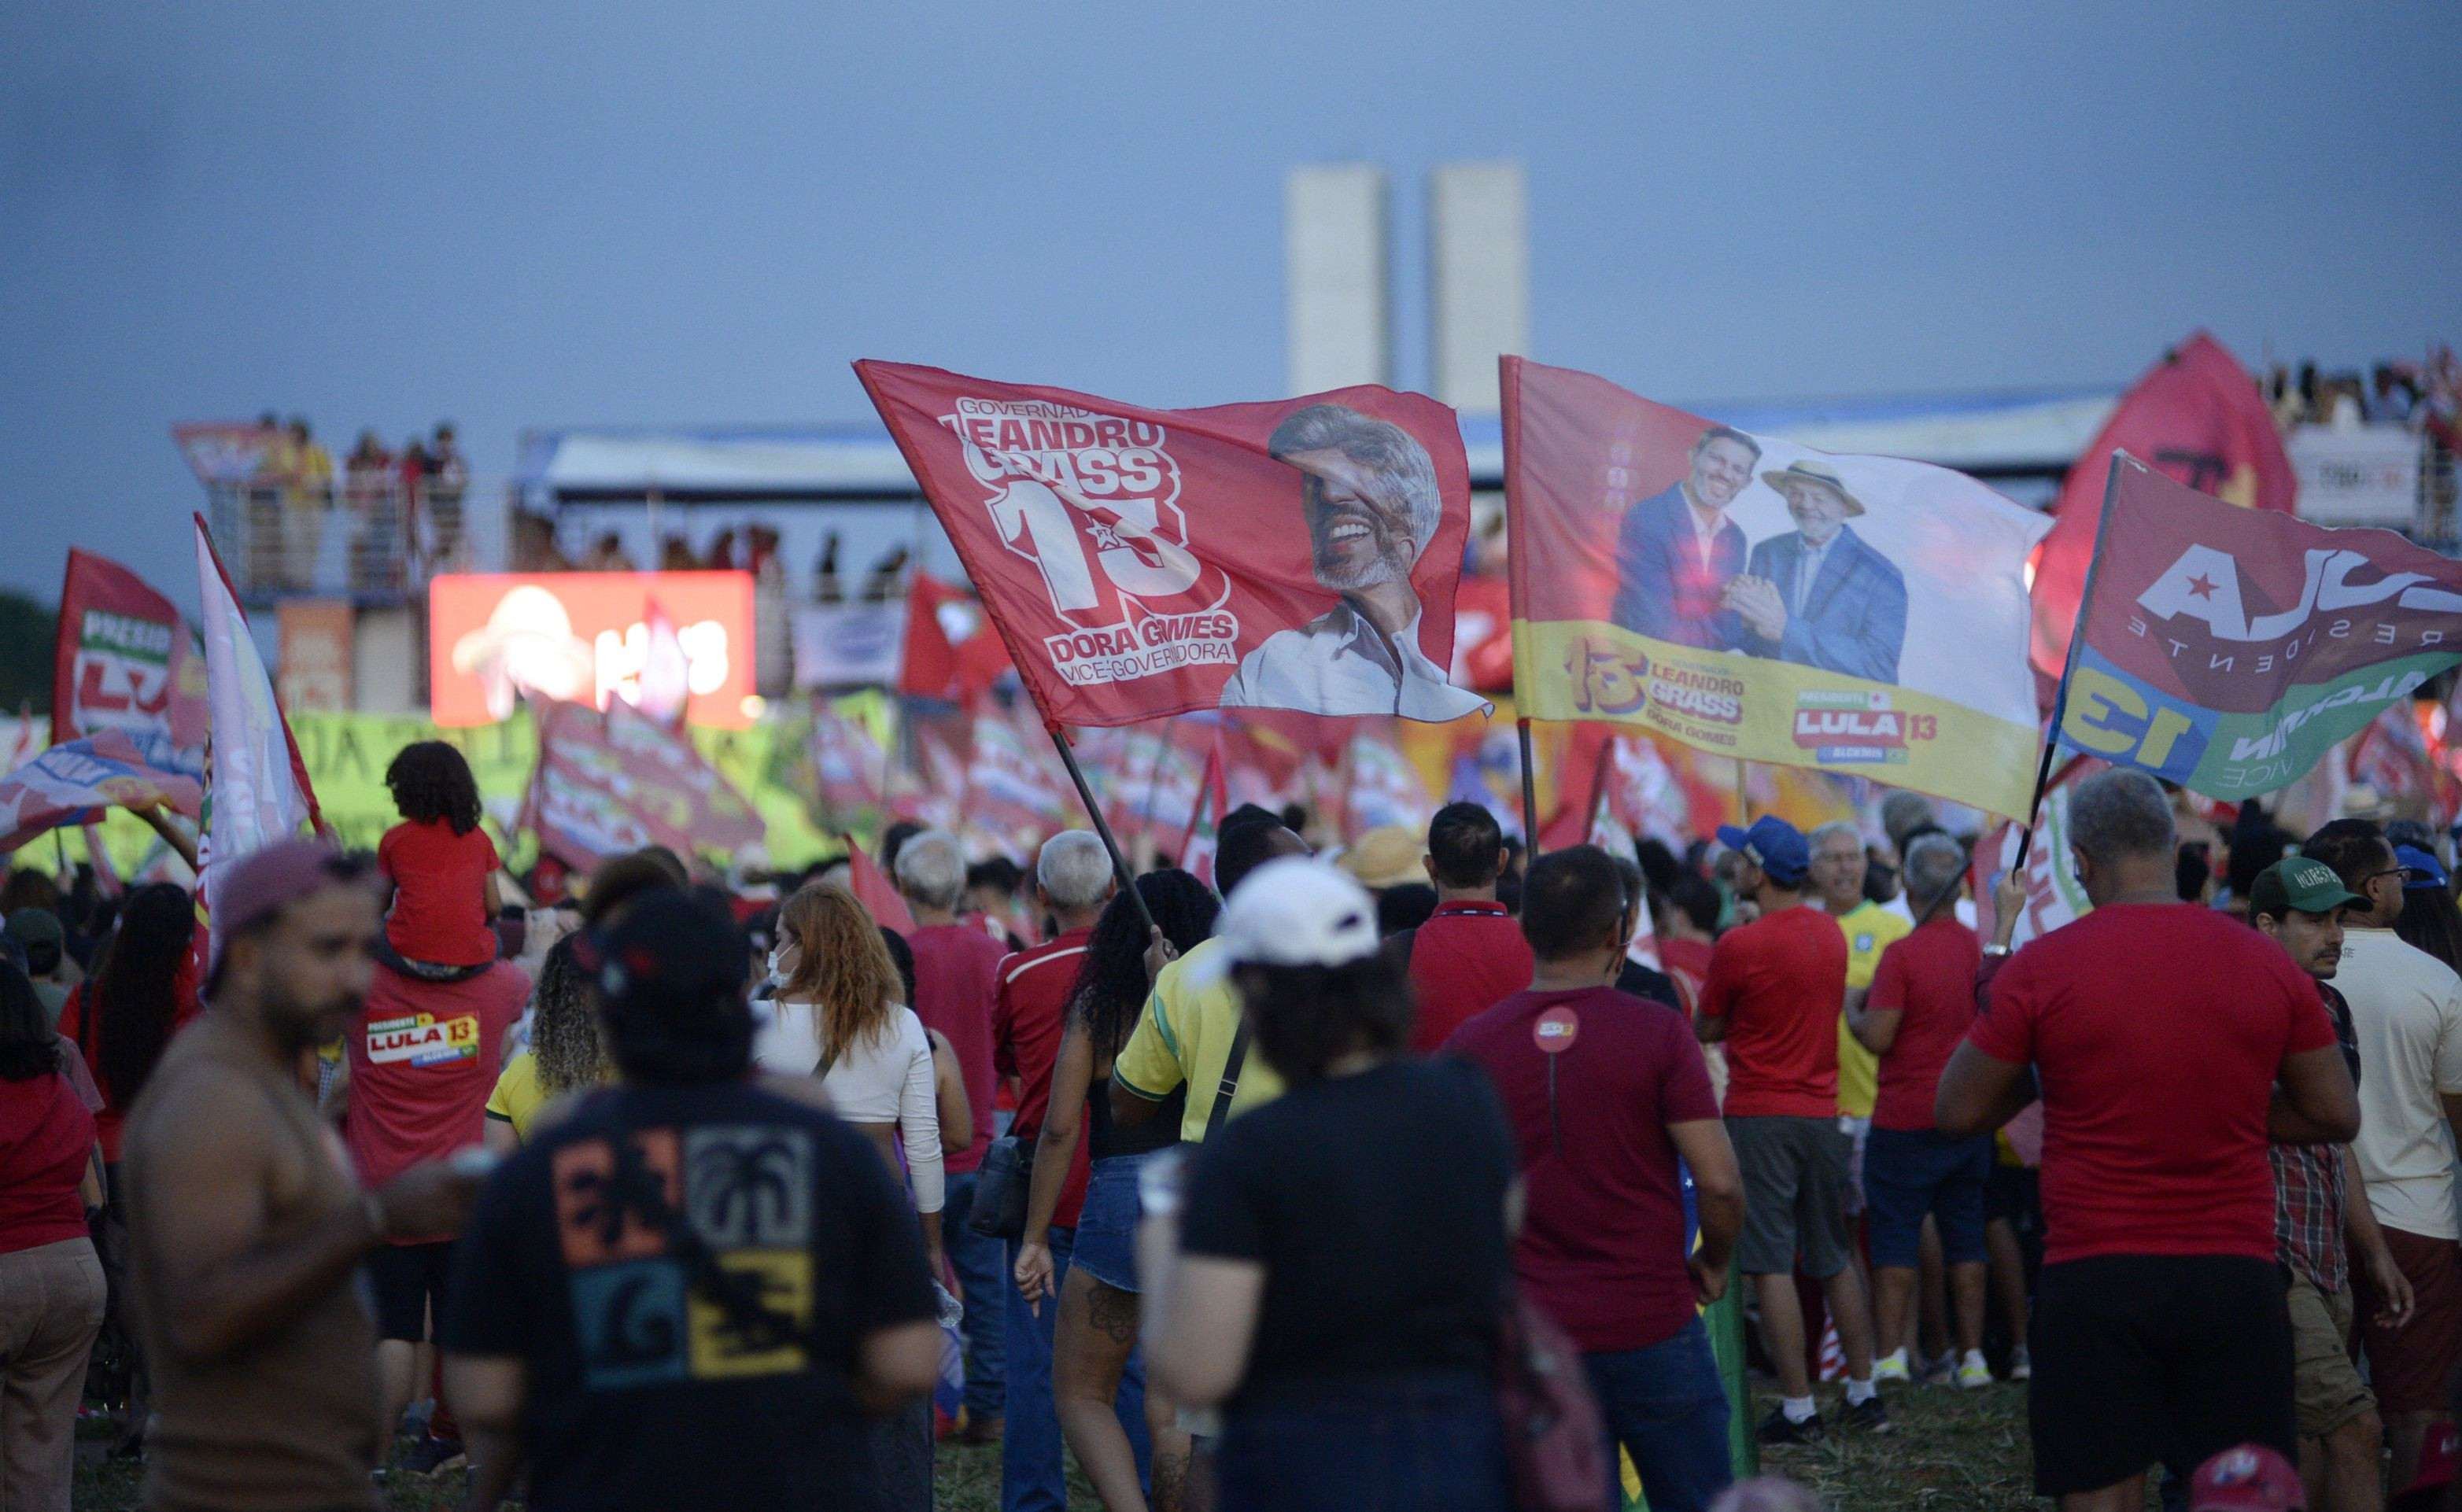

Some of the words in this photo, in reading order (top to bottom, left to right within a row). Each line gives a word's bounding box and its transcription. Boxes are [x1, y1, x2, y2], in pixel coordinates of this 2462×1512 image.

[961, 399, 1090, 418] GOVERNAD
[992, 481, 1201, 611] 13
[1096, 529, 1109, 538] PT
[1050, 628, 1140, 663] DORA
[1061, 643, 1231, 681] VICE-GOVERDORA
[1563, 637, 1650, 714] 13
[1652, 662, 1744, 696] LEANDRO
[1650, 680, 1742, 721] GRASS
[1796, 711, 1900, 736] LULA
[1910, 714, 1938, 740] 13
[371, 1027, 442, 1051] LULA
[450, 1022, 470, 1041] 13
